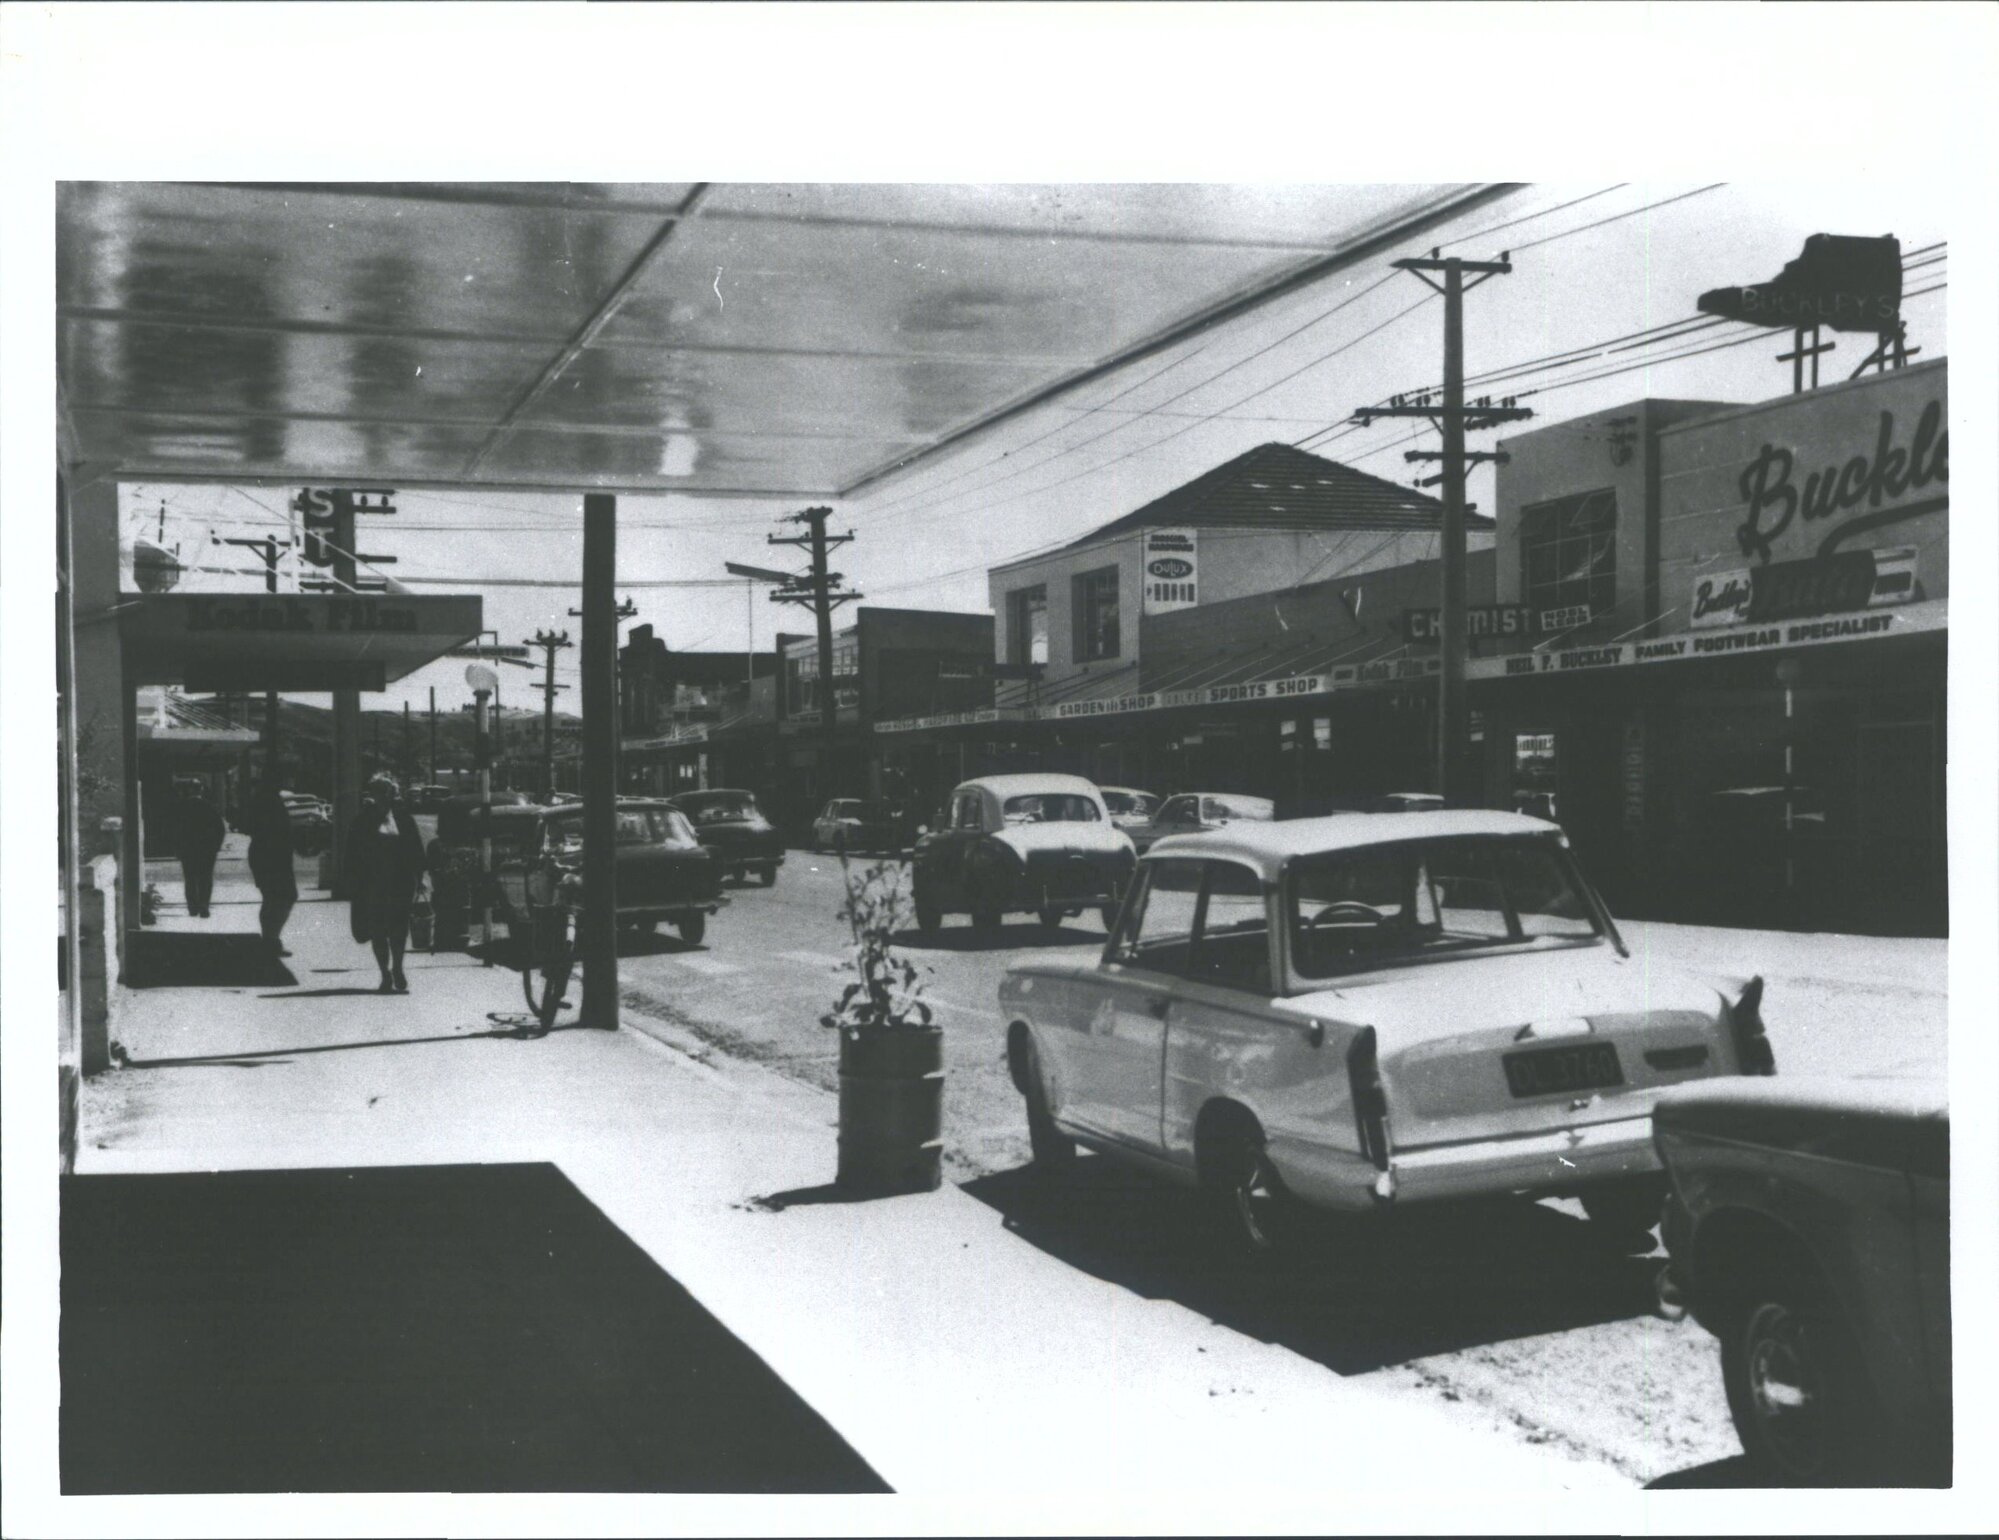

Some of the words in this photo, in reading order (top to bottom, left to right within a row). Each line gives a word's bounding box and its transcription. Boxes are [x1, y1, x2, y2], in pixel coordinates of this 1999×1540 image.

[1411, 610, 1532, 640] CHMIST
[1560, 646, 1623, 668] BUCKLEY
[1635, 641, 1686, 660] FAMILY
[1693, 628, 1781, 653] FOOTWEAR
[1787, 613, 1894, 642] SPECIALIST
[1209, 682, 1267, 702] SPORTS
[1275, 676, 1319, 695] SHOP
[1058, 702, 1105, 717] GARDEN
[1119, 695, 1155, 711] SHOP
